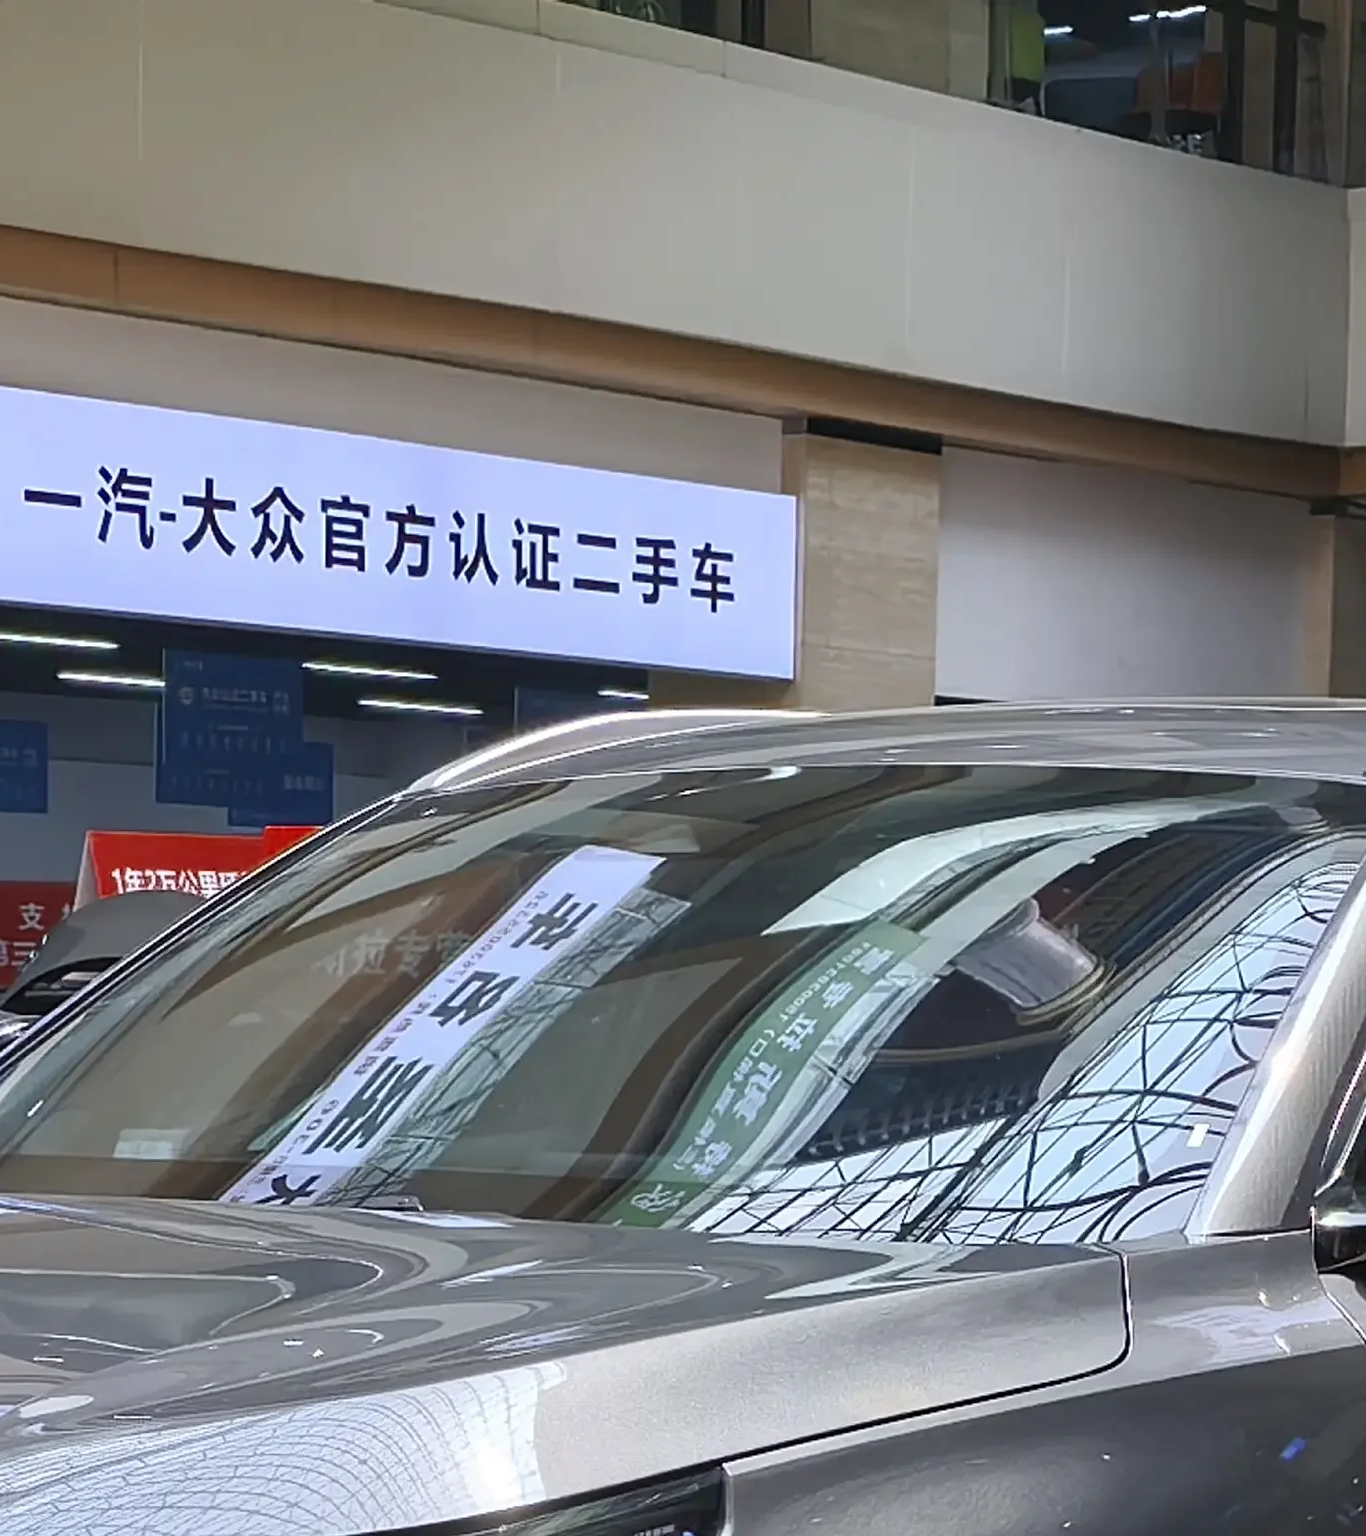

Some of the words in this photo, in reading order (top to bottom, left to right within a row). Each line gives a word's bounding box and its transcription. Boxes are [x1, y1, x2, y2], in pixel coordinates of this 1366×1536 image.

[22, 464, 735, 613] 一汽-大众官方认证二手车
